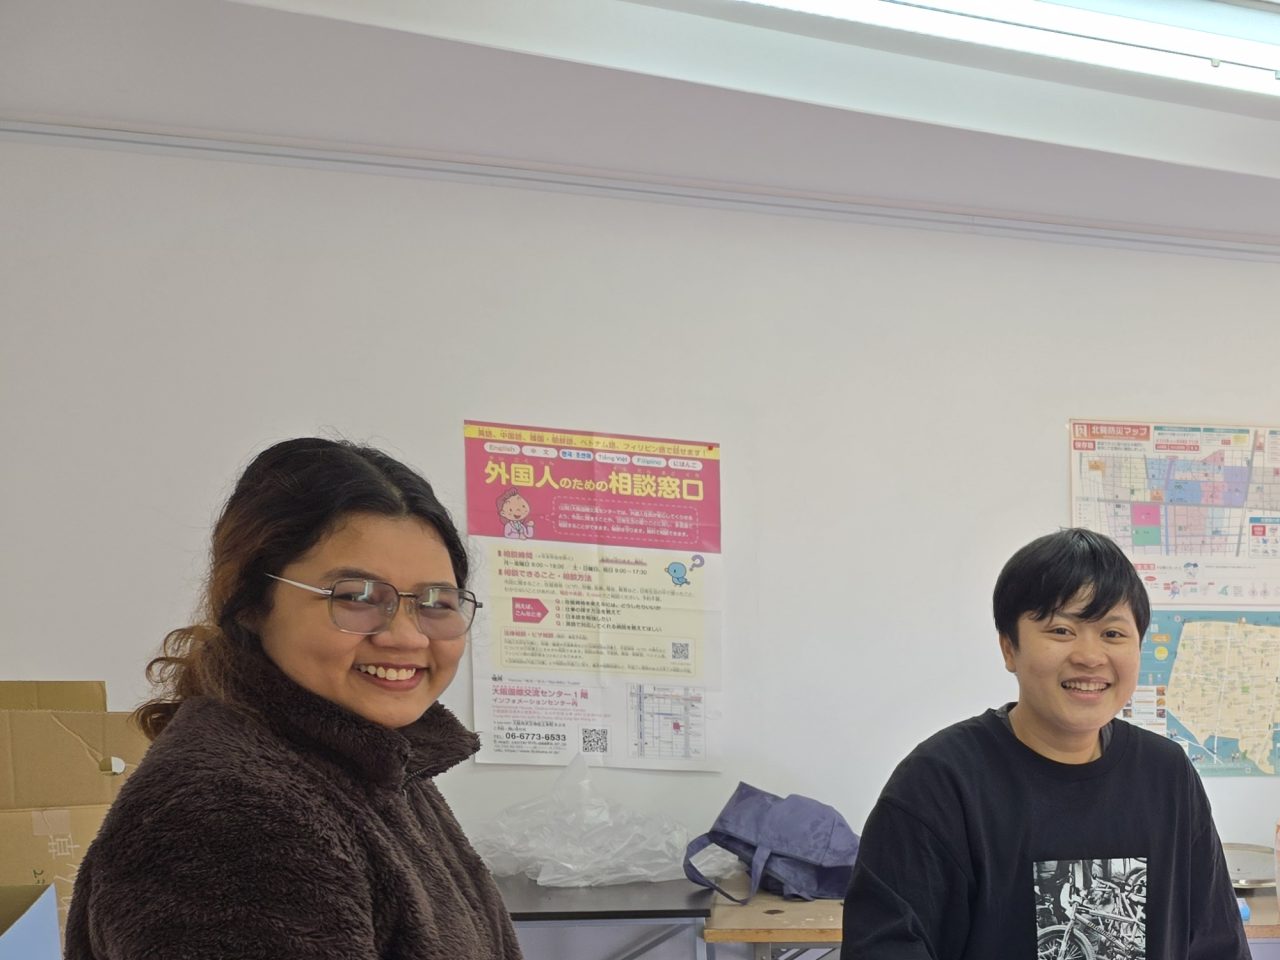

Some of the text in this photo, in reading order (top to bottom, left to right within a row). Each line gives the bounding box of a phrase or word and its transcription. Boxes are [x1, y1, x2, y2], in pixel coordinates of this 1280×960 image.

[484, 460, 705, 501] 外国人のための相談窓口
[505, 732, 567, 742] 06-6773-6533
